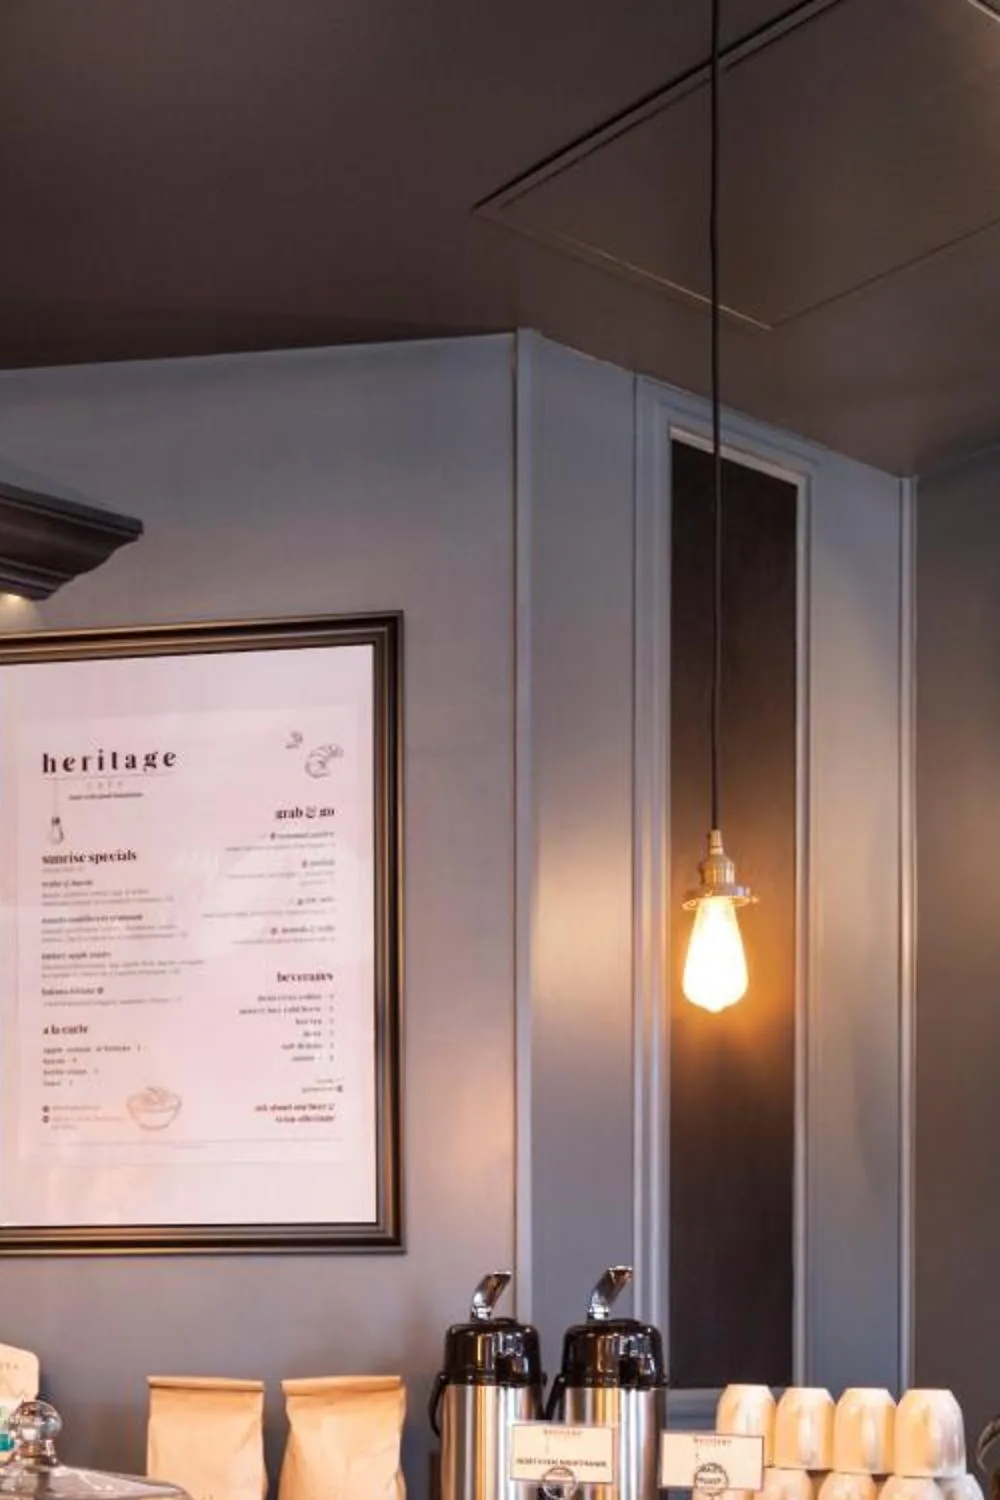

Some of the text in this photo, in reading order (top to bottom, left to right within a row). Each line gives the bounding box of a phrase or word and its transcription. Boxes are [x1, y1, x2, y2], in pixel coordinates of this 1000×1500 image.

[42, 748, 177, 774] heritage
[276, 806, 303, 820] grab
[42, 849, 138, 865] sunrise specials
[277, 971, 334, 984] beverages
[51, 1024, 60, 1035] la
[62, 1024, 88, 1035] carte
